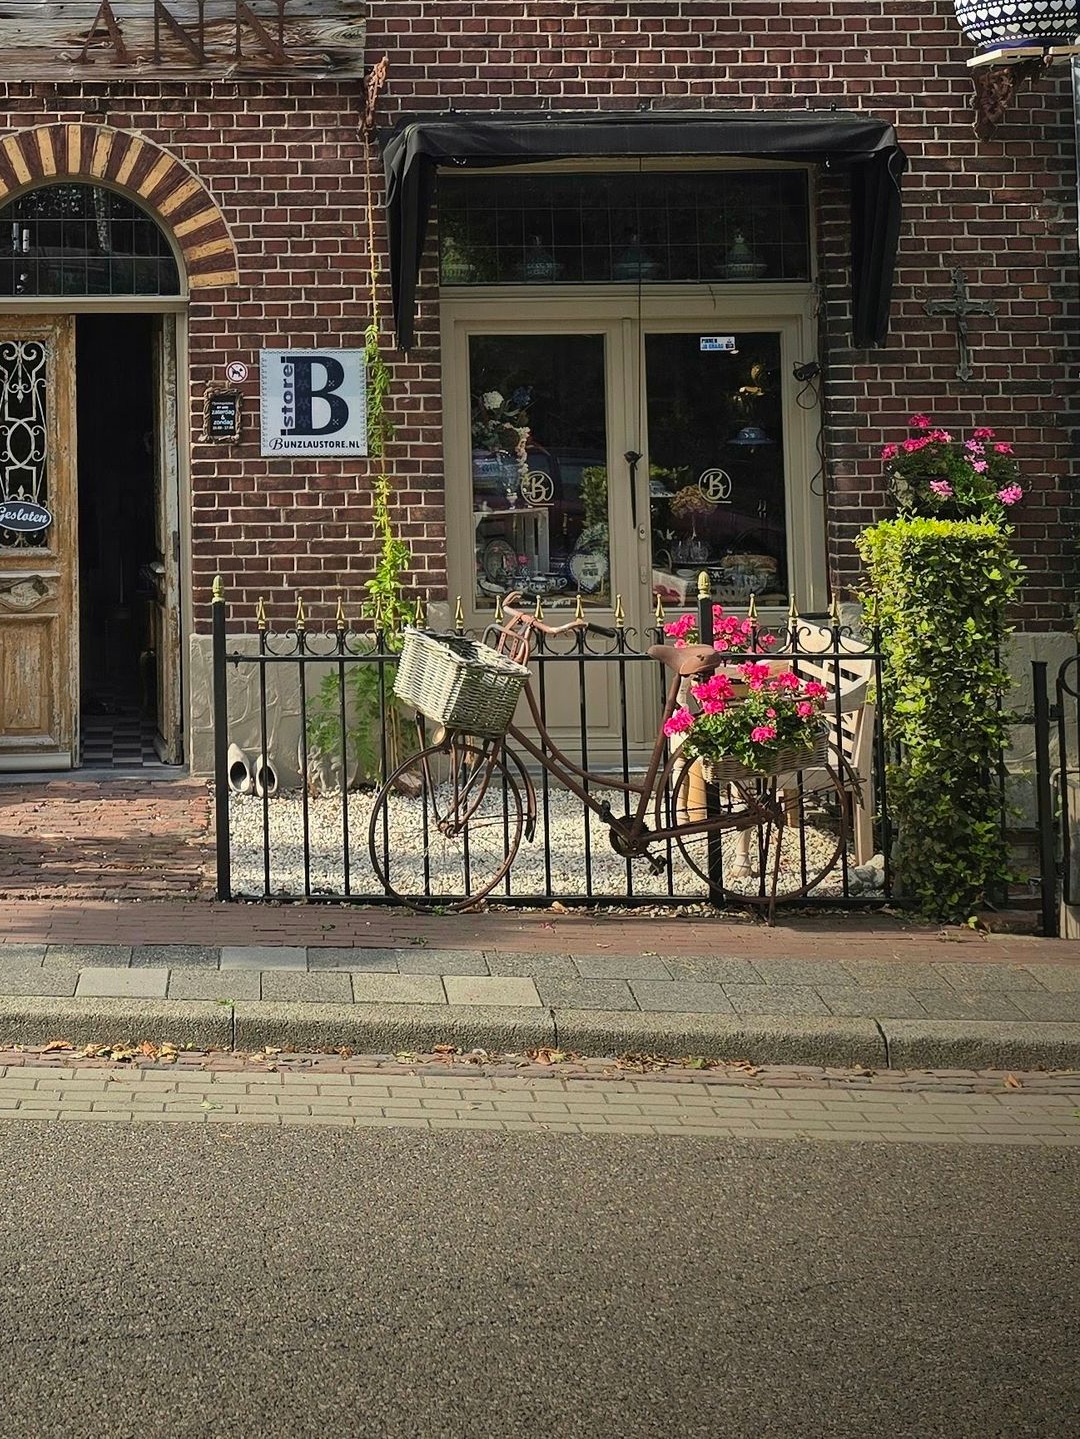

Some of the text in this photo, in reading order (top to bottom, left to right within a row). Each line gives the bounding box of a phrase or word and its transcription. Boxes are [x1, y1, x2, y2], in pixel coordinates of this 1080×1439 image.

[281, 356, 349, 436] B
[282, 364, 294, 427] store
[269, 437, 360, 451] BUNZLAUSTORE.NL
